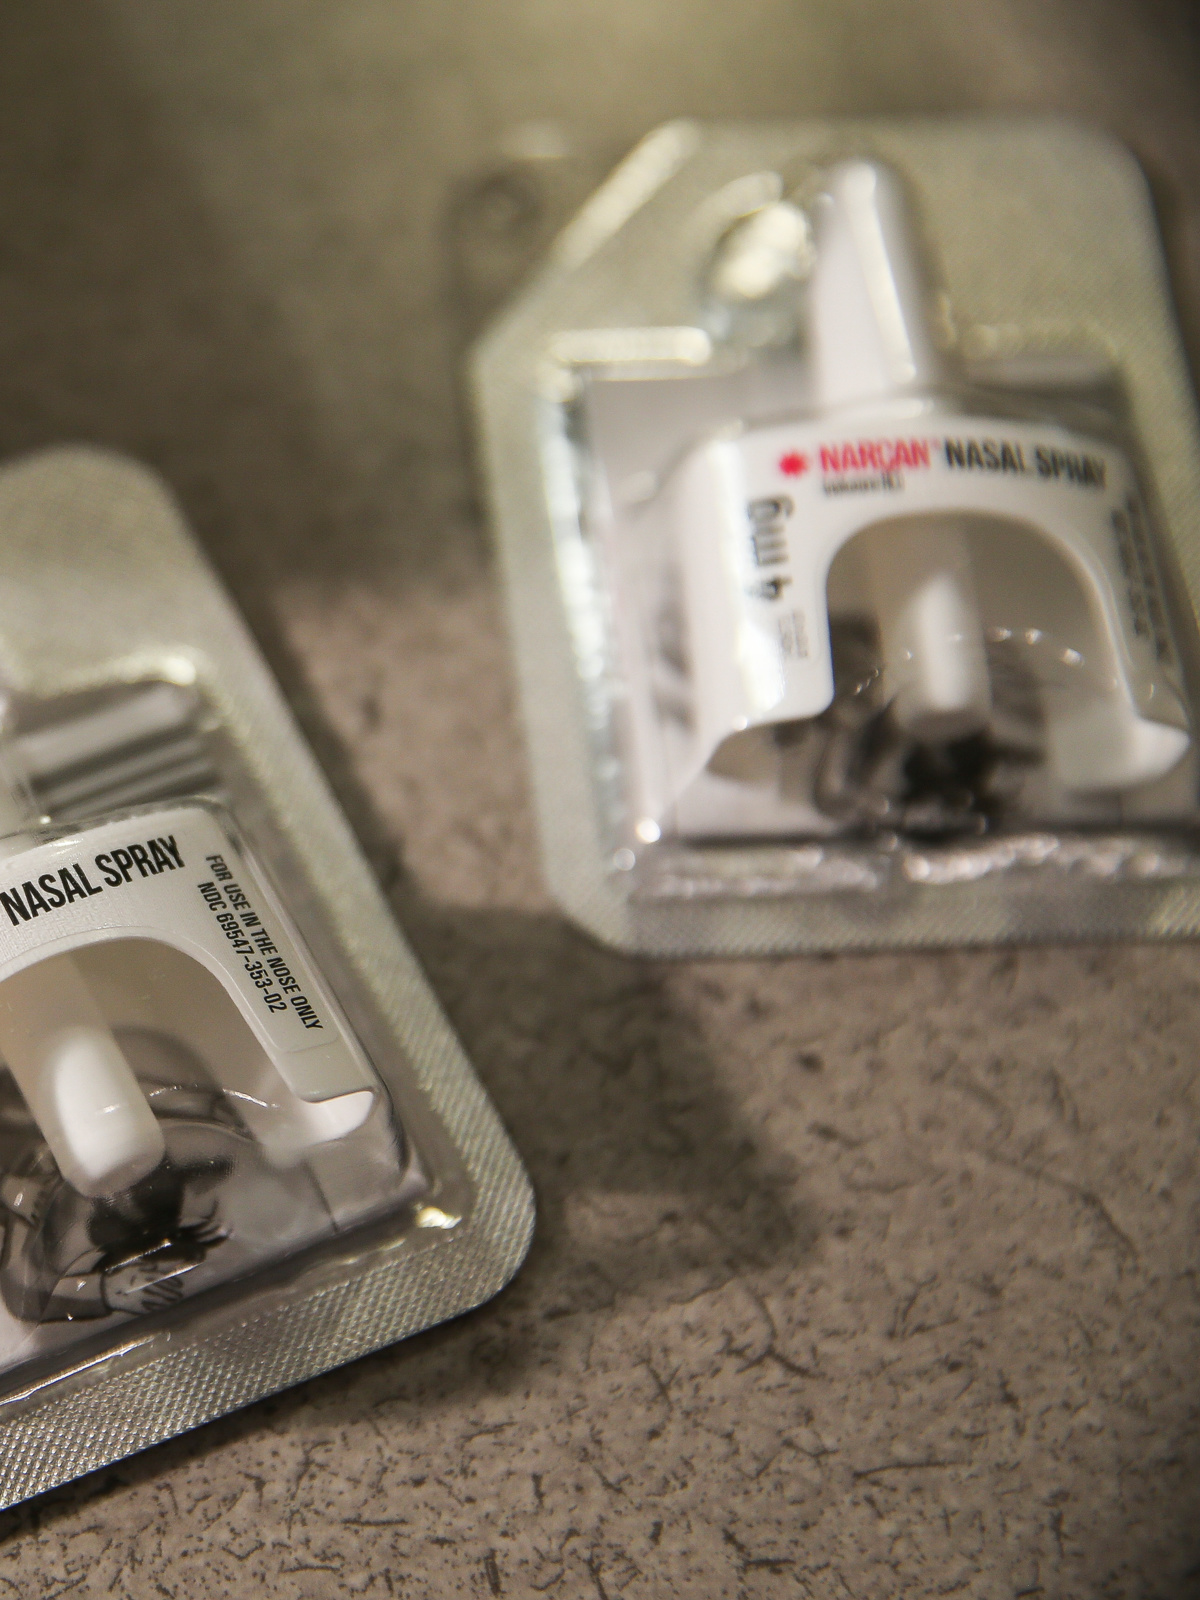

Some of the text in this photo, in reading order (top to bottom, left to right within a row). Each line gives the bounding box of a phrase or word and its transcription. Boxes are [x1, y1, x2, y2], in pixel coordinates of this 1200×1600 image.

[818, 436, 1108, 489] NARCAN NASAL SPRAY
[747, 494, 796, 567] mg
[95, 835, 185, 887] SPRAY
[197, 881, 288, 1014] NDC 69547-353-02
[205, 854, 324, 1030] FOR USE IN THE NOSE ONLY
